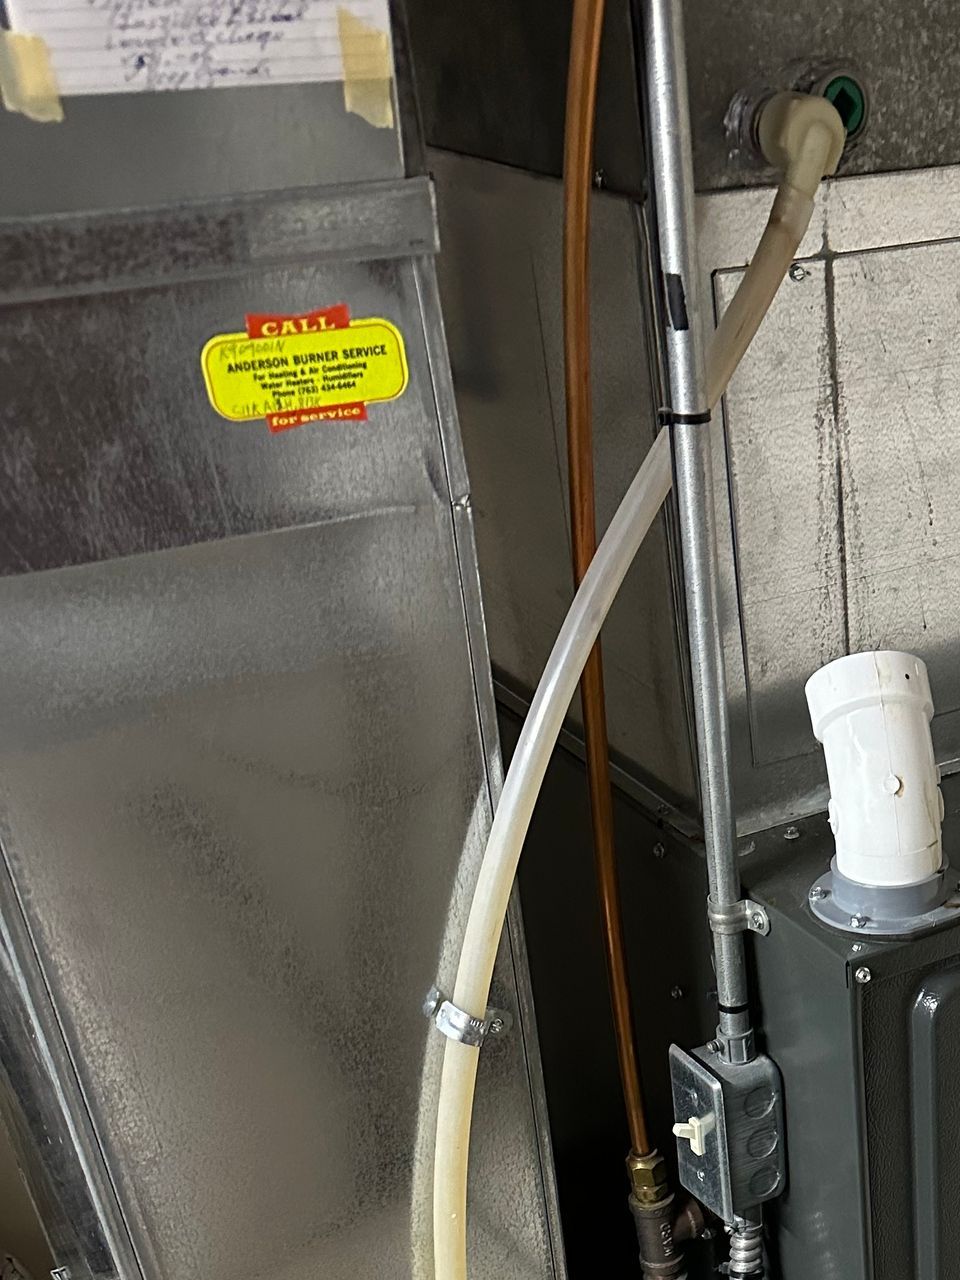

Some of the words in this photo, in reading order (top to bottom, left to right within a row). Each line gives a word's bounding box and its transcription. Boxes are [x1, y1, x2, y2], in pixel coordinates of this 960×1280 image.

[261, 316, 335, 336] CALL
[227, 357, 289, 373] ANDERSON
[293, 351, 339, 365] BURNER
[342, 344, 387, 359] SERVICE
[253, 372, 266, 381] For
[268, 369, 298, 380] Heating
[300, 367, 307, 376] &
[309, 366, 319, 375] Air
[322, 361, 368, 373] Conditioning
[261, 380, 283, 390] Water
[286, 377, 315, 387] Heaters
[323, 371, 364, 382] Humidifiers
[272, 389, 296, 398] Phone
[271, 415, 297, 427] for
[300, 405, 361, 422] service
